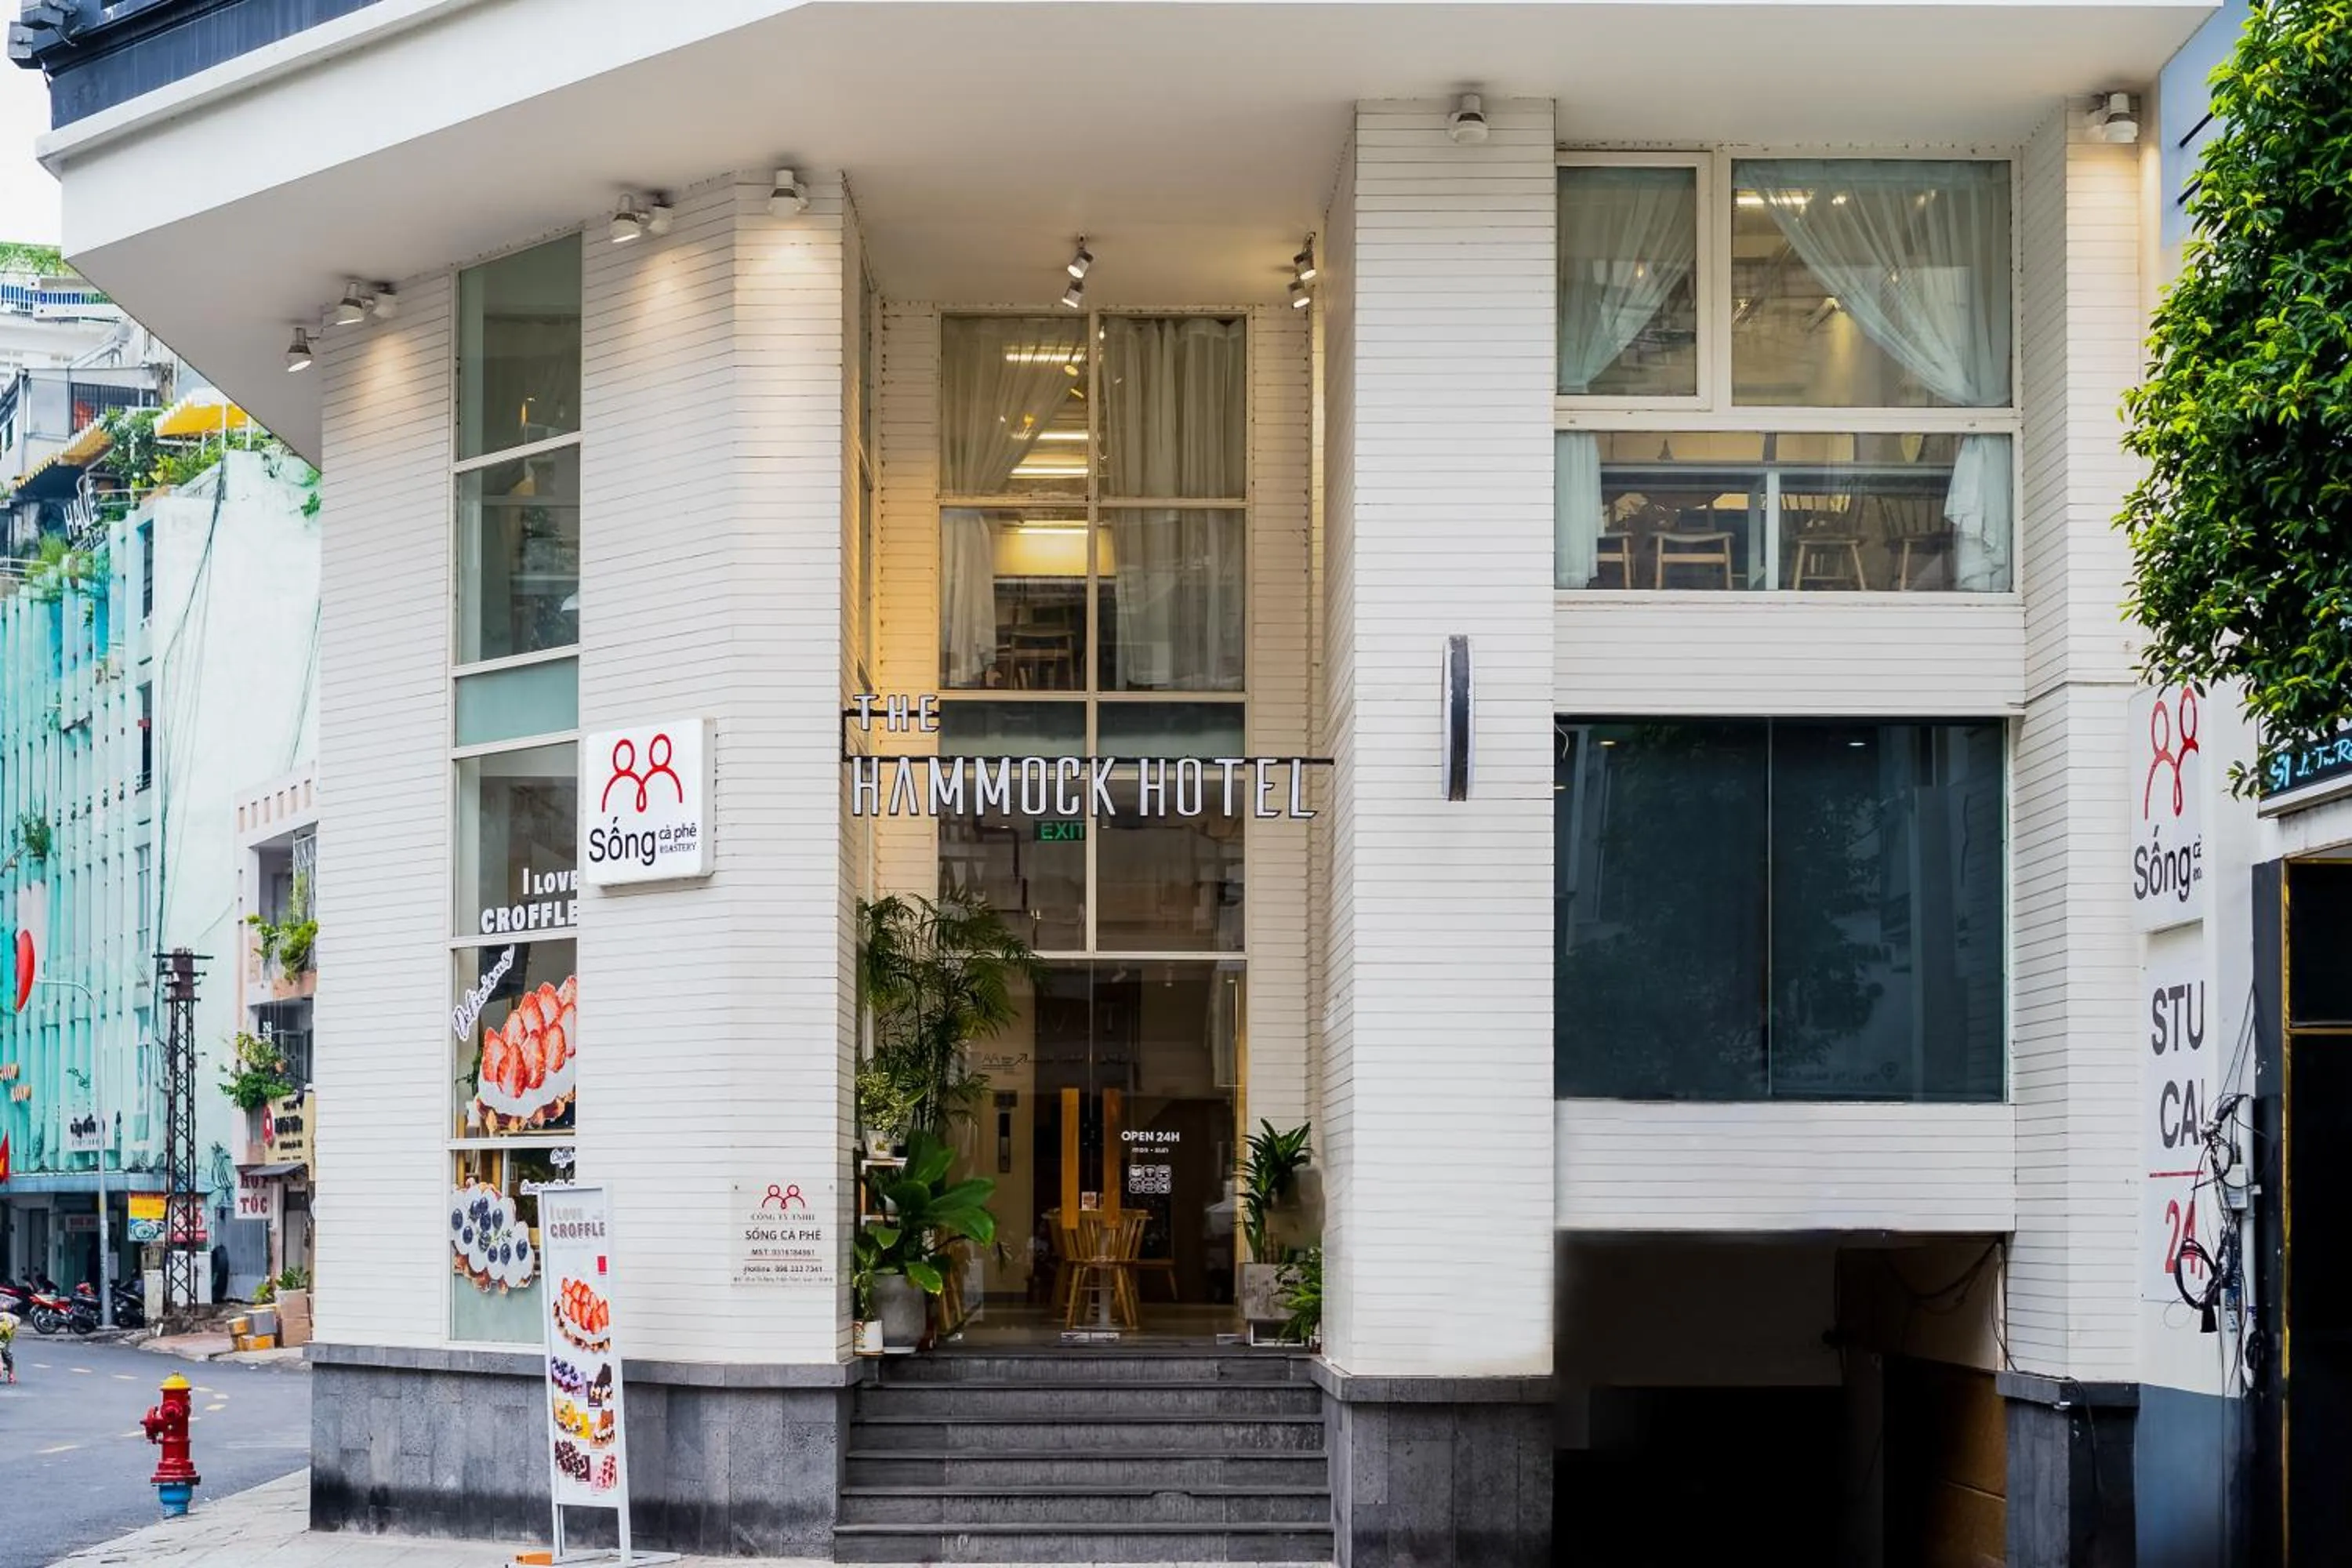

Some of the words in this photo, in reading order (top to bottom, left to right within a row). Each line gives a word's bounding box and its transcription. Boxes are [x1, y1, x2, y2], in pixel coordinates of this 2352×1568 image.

[853, 695, 939, 732] THE
[852, 755, 1116, 817] HAMMOCK
[1138, 756, 1318, 818] HOTEL
[589, 816, 655, 866] Sống
[659, 824, 672, 840] cà
[673, 822, 697, 843] phê
[1040, 822, 1086, 840] EXIT
[2134, 824, 2190, 902] Sống
[523, 868, 529, 895] I
[481, 899, 577, 934] CROFFLE
[2151, 979, 2204, 1056] STU
[1121, 1131, 1154, 1142] OPEN
[1156, 1131, 1180, 1142] 24H
[240, 1192, 267, 1214] TÓC
[550, 1221, 605, 1240] CROFFLE
